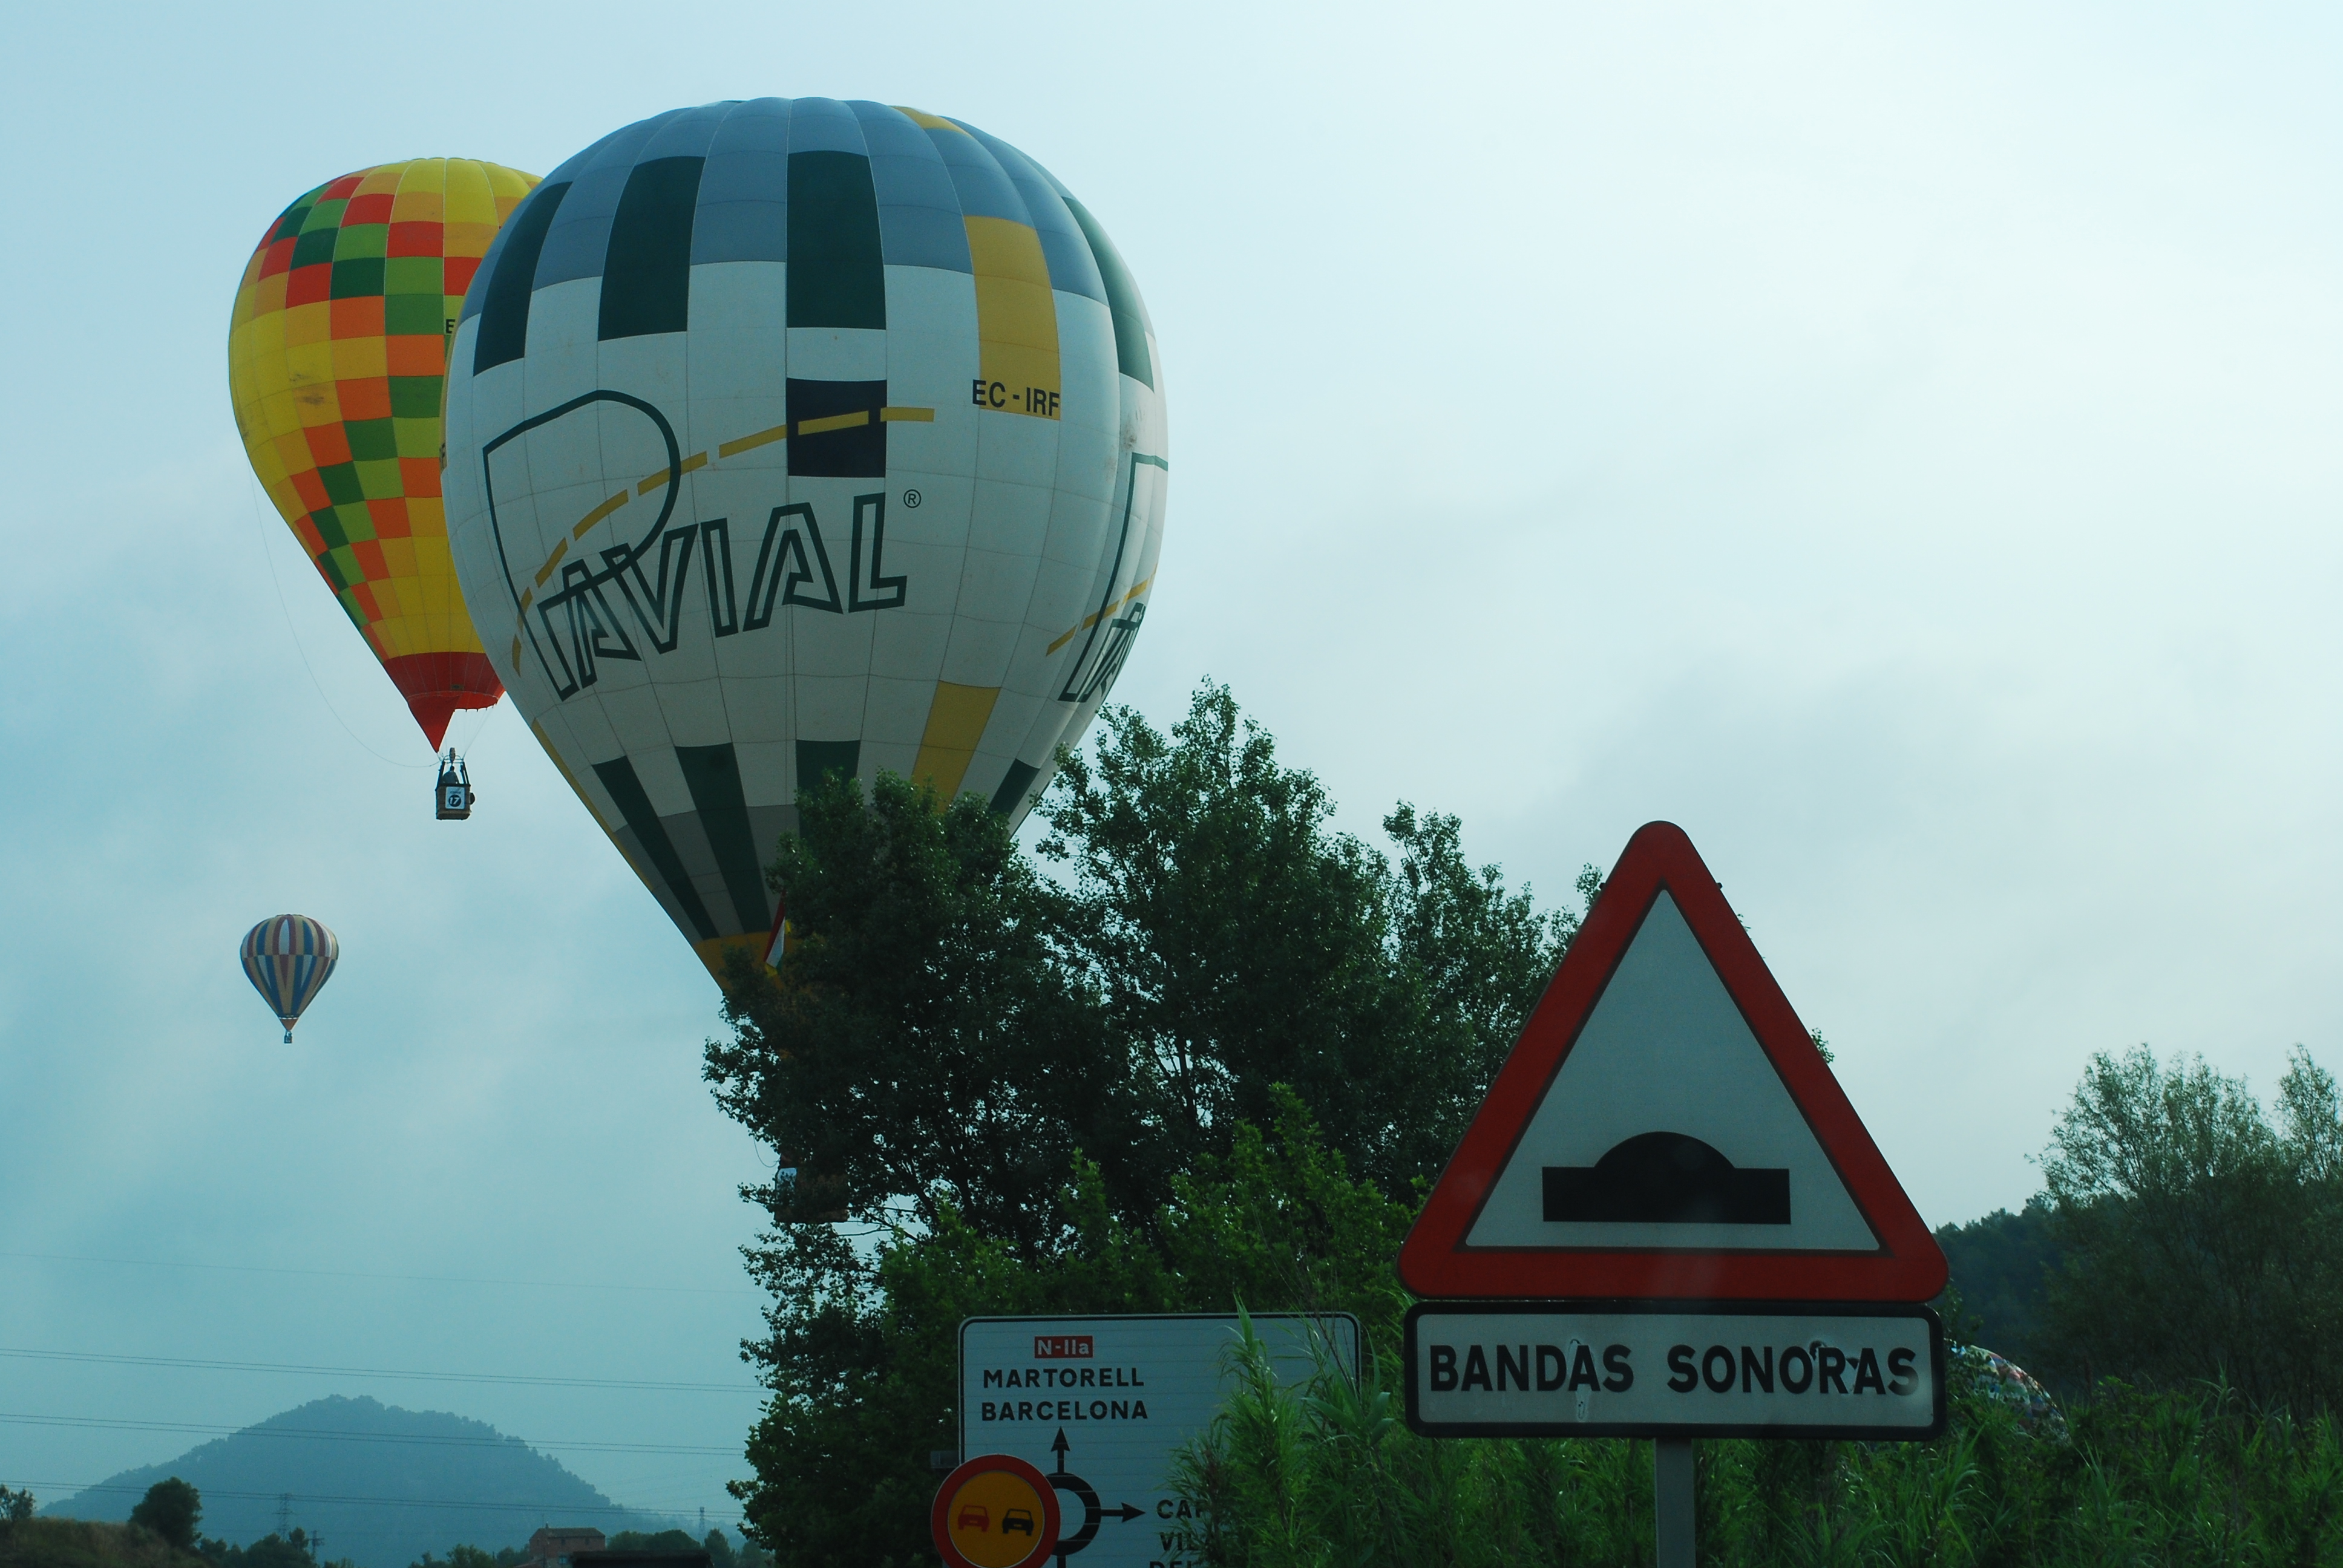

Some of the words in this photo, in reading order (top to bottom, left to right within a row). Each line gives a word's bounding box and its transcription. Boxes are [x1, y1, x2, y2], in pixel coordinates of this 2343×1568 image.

[983, 1367, 1144, 1388] MARTORELL
[1430, 1343, 1634, 1393] BANDAS
[1667, 1344, 1919, 1397] SONORAS
[981, 1400, 1149, 1421] BARCELONA
